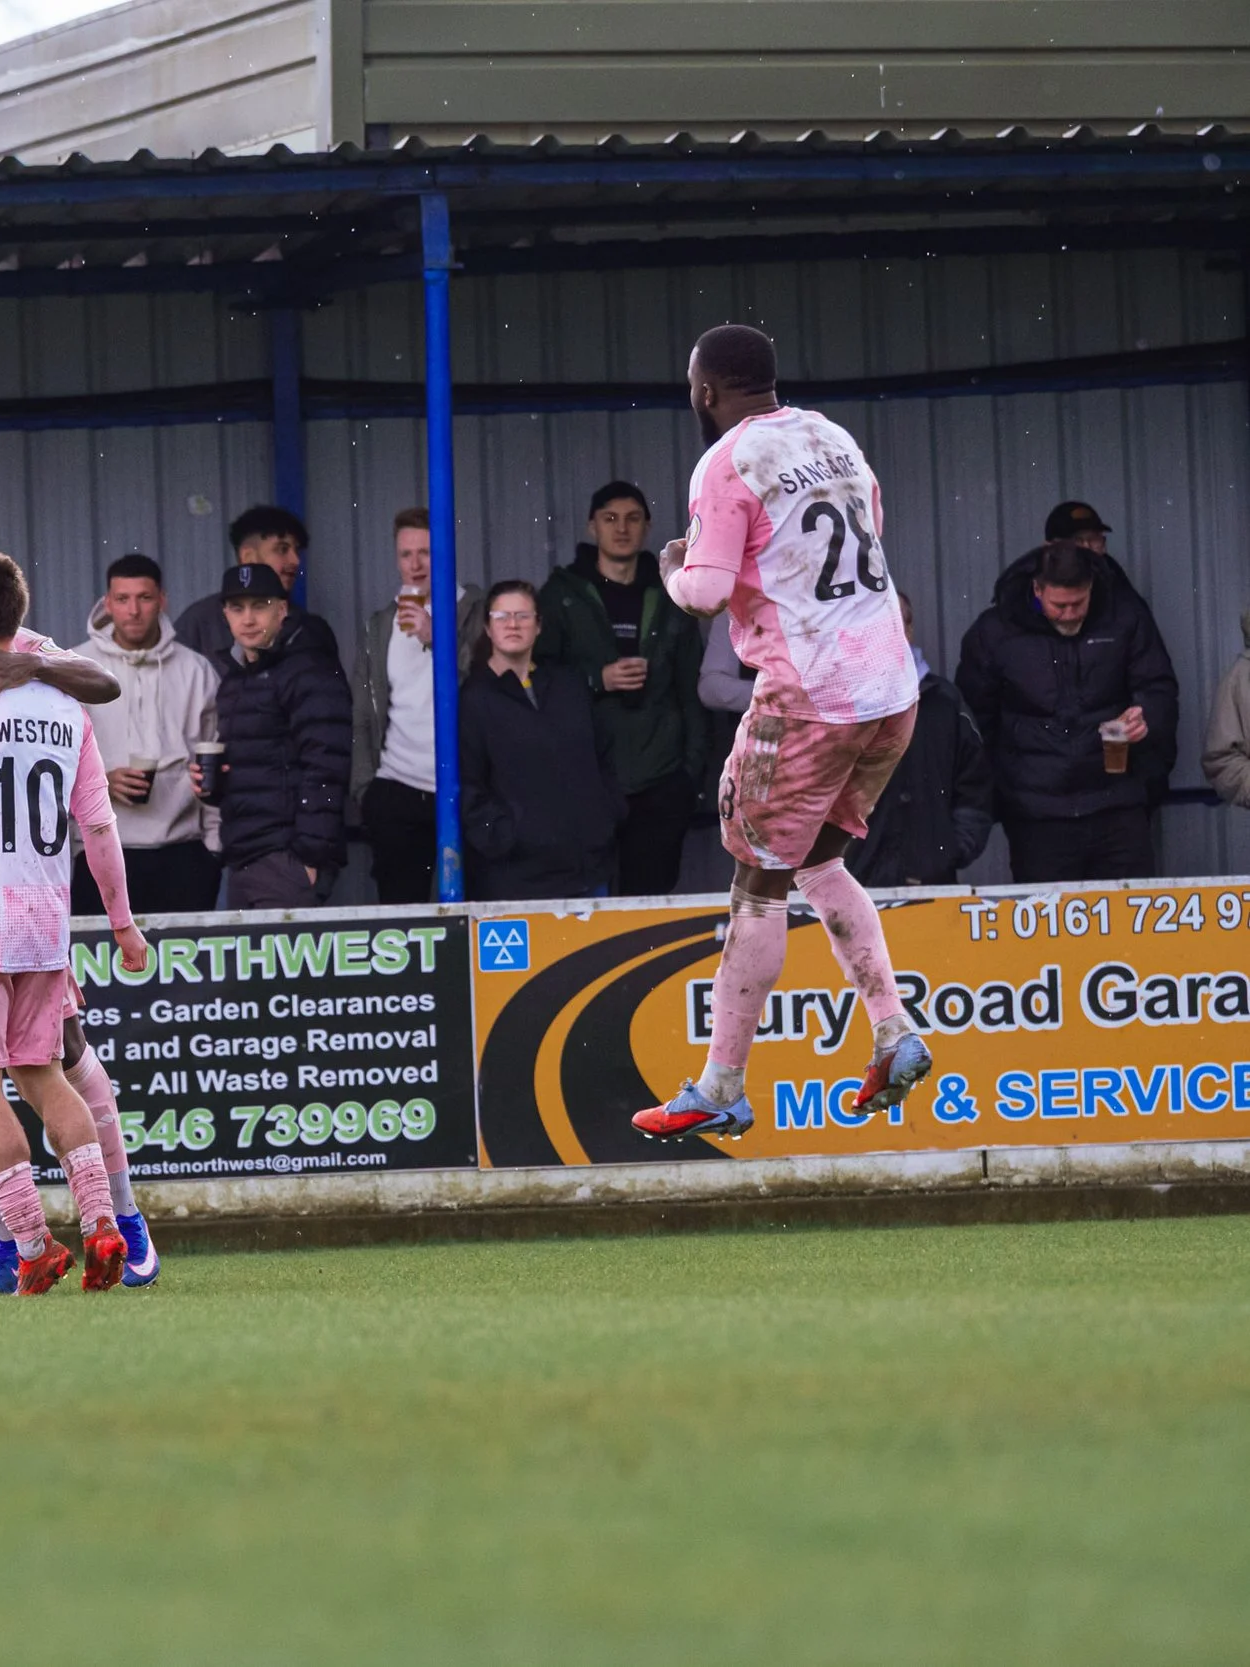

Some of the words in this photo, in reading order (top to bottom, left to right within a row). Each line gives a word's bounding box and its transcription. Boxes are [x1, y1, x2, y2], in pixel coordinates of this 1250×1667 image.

[960, 903, 997, 941] T:
[1012, 897, 1110, 939] 0161
[1127, 893, 1205, 934] 724
[68, 927, 447, 988] NORTHWEST
[149, 999, 259, 1024] Garden
[268, 993, 436, 1019] Clearances
[124, 1036, 180, 1061] and
[189, 1033, 297, 1060] Garage
[306, 1024, 437, 1053] Removal
[148, 1071, 188, 1095] All
[196, 1070, 289, 1093] Waste
[298, 1060, 438, 1089] Removed
[934, 1073, 980, 1124] &
[230, 1098, 437, 1149] 739969
